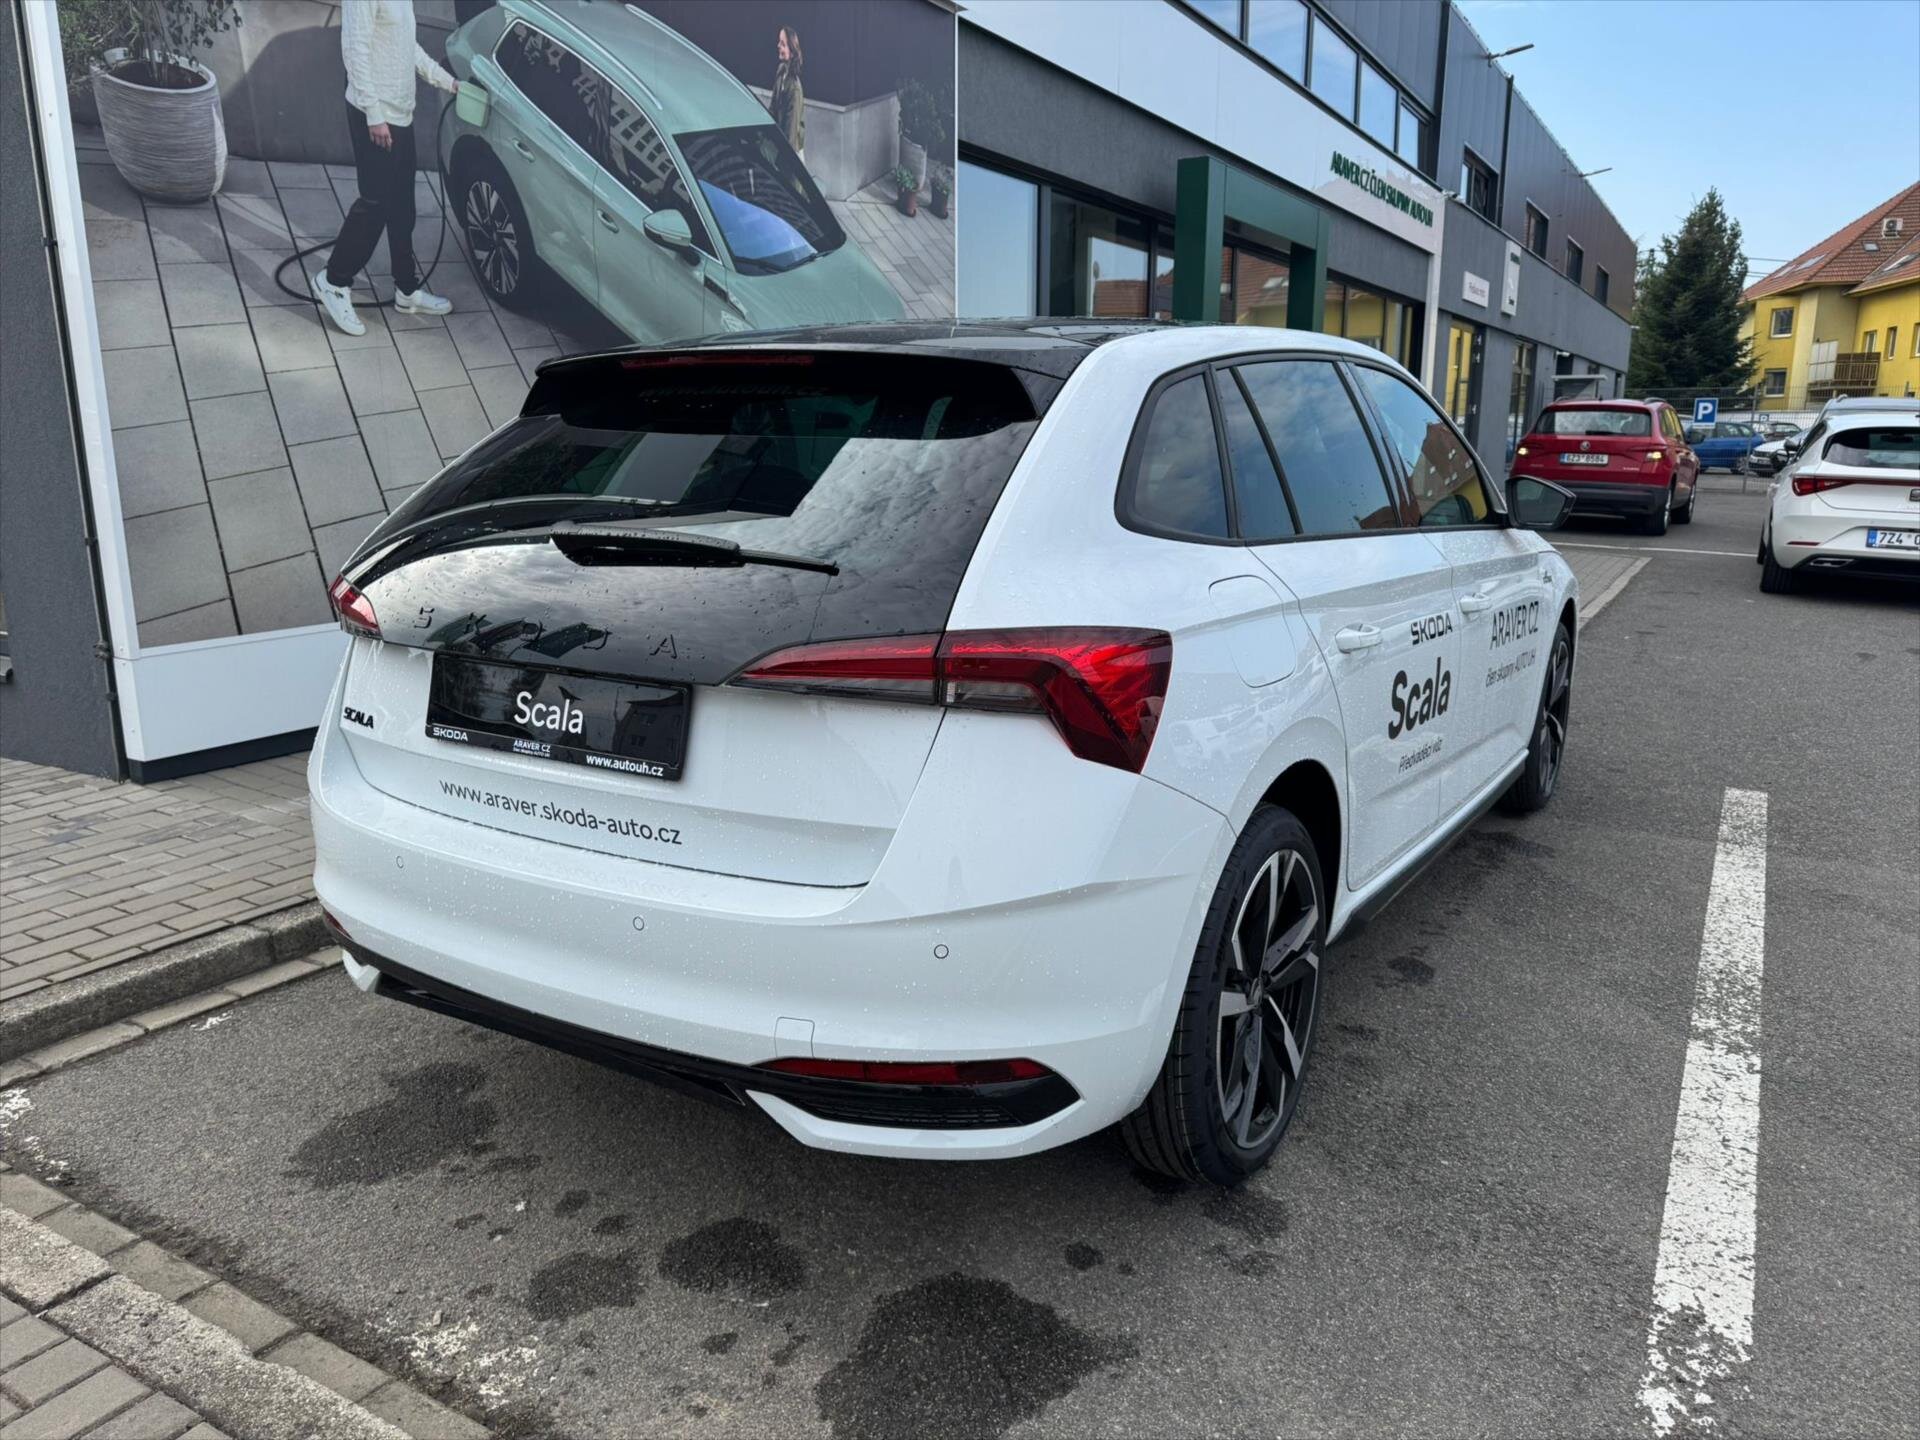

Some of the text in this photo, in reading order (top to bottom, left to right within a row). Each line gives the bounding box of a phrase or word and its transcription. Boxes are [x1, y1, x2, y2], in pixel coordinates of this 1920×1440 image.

[1330, 151, 1360, 186] ARAVER
[1697, 402, 1713, 420] P
[1879, 532, 1903, 545] 7Z4
[1489, 600, 1540, 650] ARAVER CZ
[1388, 656, 1452, 740] Scala
[343, 706, 374, 729] SCALA
[513, 691, 584, 736] Scala
[513, 739, 540, 751] ARAVER
[541, 743, 551, 753] CZ
[585, 753, 664, 777] www.autouh.cz
[438, 778, 682, 846] www.araver.skoda-auto.cz
